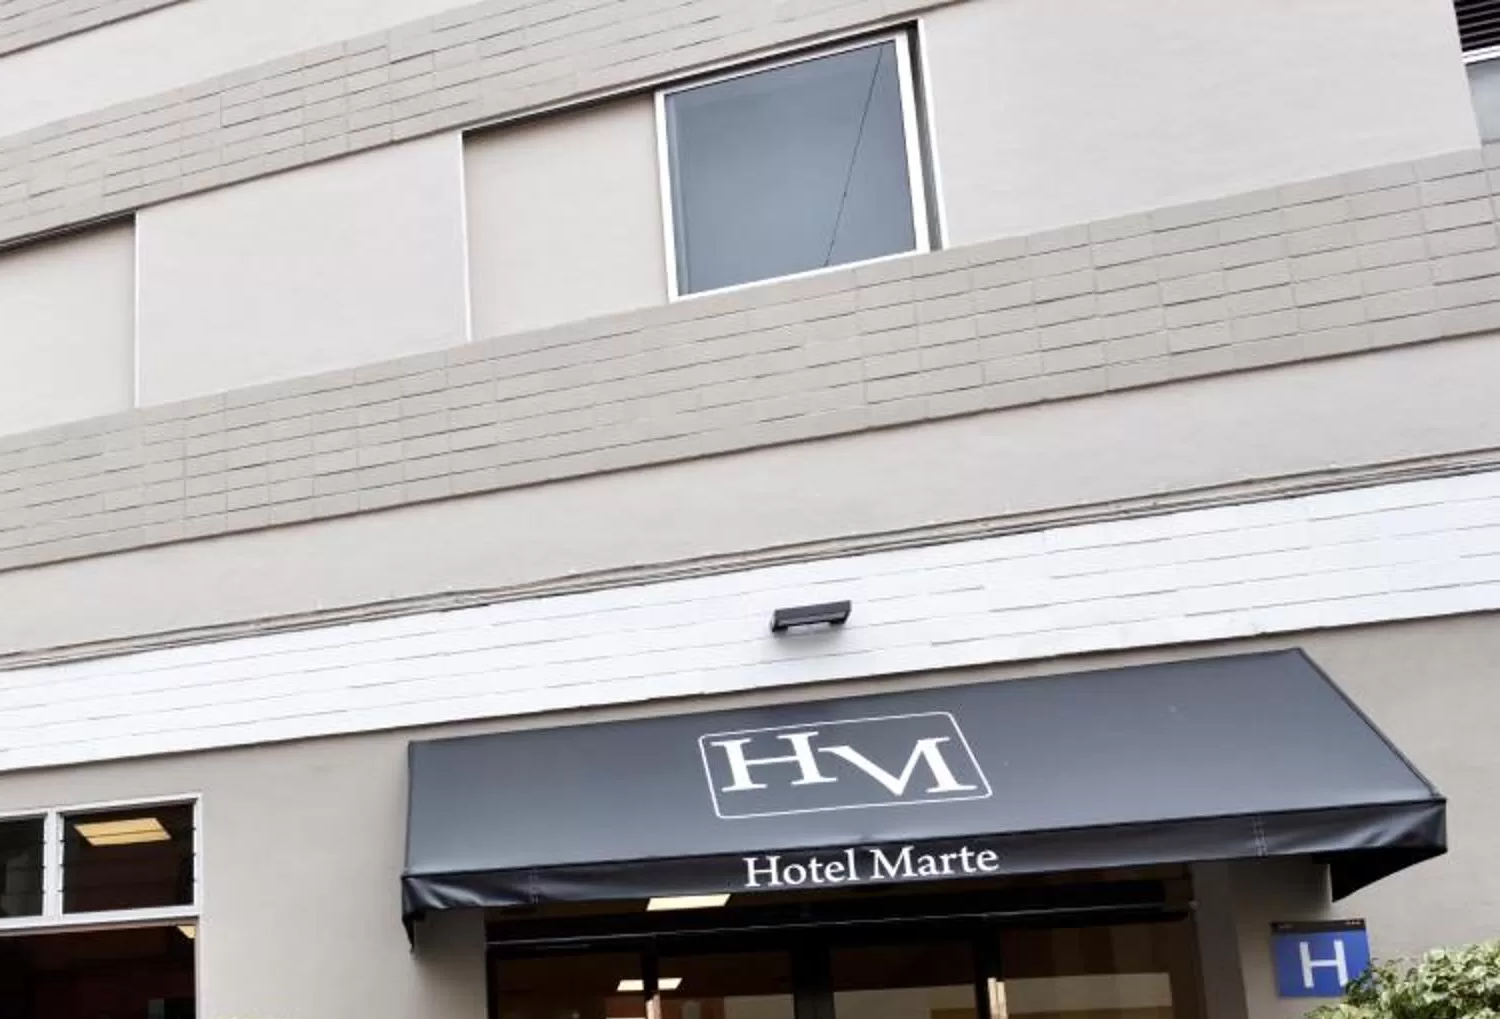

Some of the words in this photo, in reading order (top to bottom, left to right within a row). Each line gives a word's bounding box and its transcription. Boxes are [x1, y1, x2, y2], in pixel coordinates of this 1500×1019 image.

[709, 730, 978, 796] HM
[743, 848, 858, 888] Hotel
[869, 845, 1000, 881] Marte
[1299, 939, 1349, 989] H
